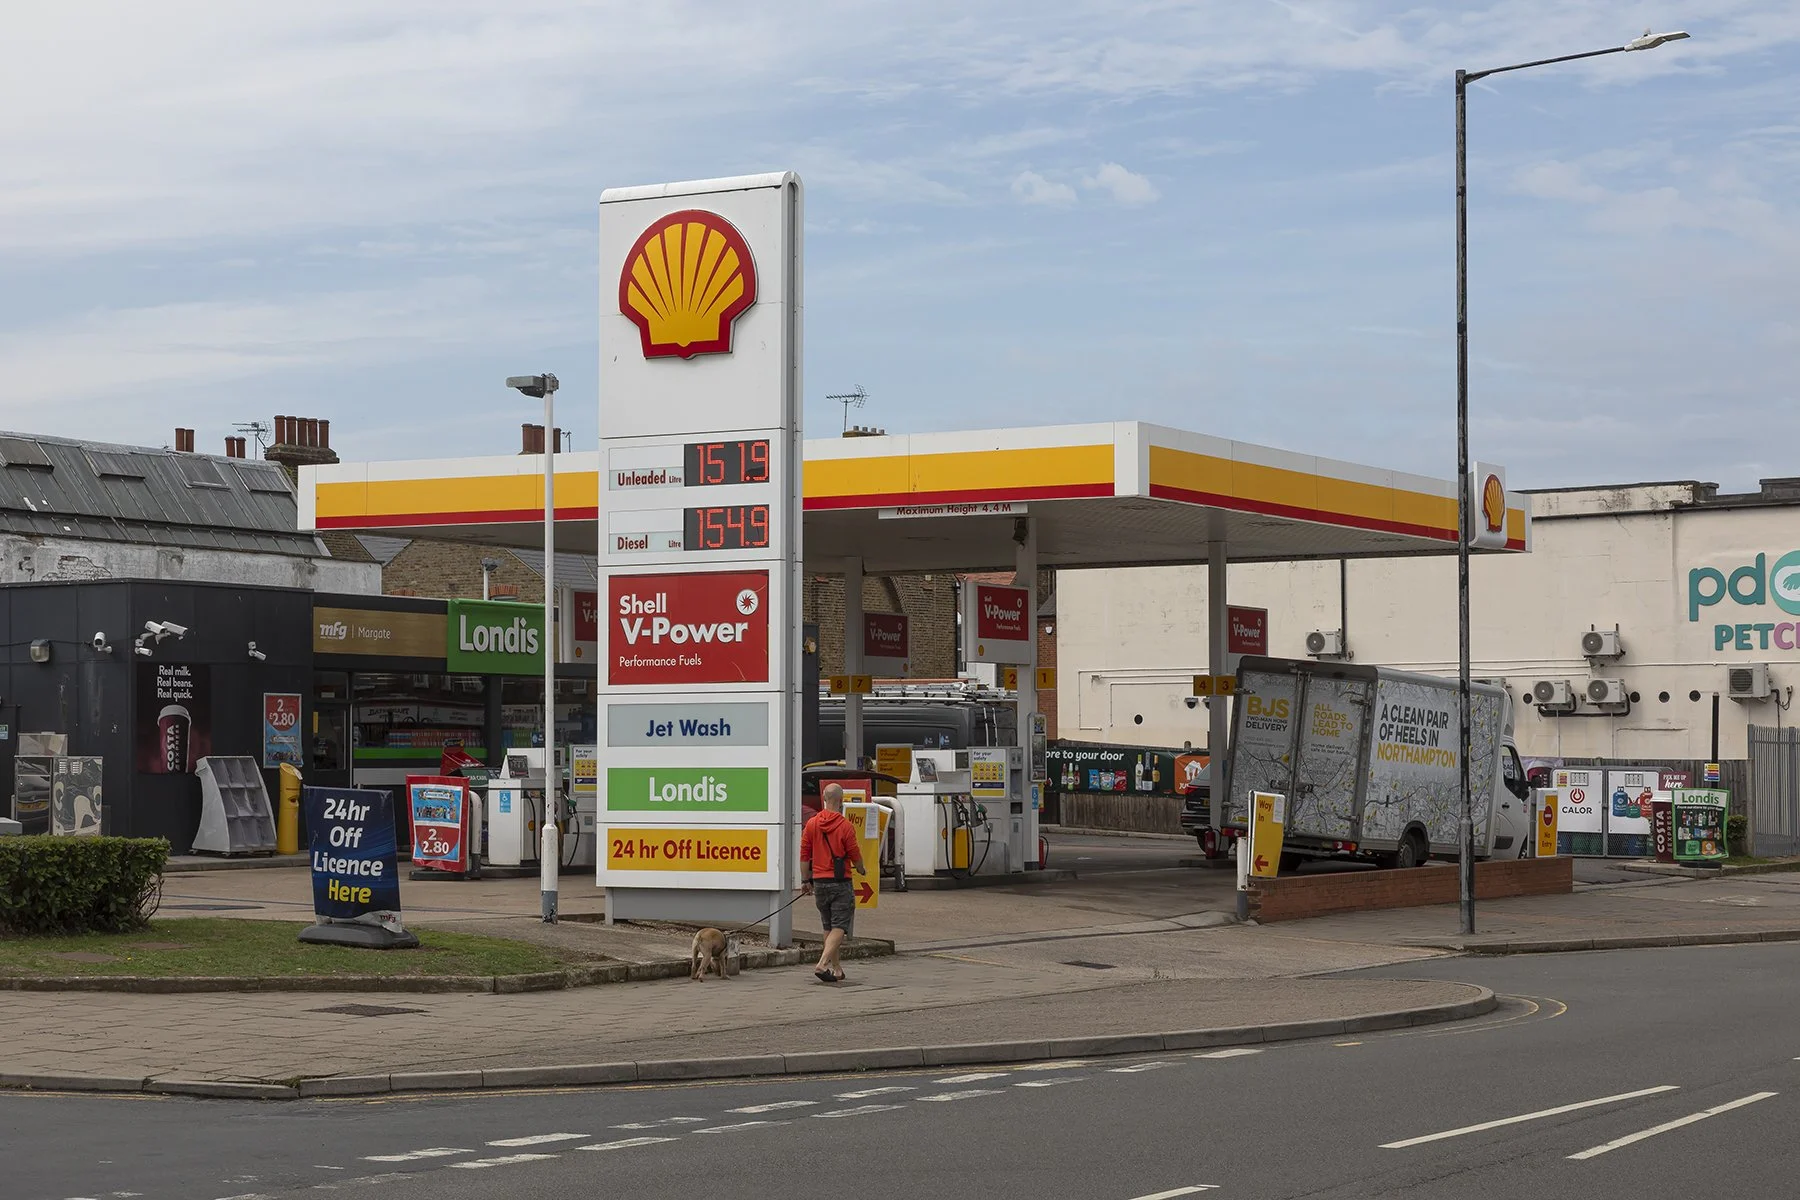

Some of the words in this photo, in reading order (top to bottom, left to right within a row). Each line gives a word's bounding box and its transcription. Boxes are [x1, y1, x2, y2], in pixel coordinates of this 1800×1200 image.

[696, 441, 769, 484] 151.9
[617, 470, 666, 487] Unleaded
[668, 475, 682, 484] Litre
[896, 507, 943, 516] Maximum
[947, 504, 977, 514] Height
[982, 504, 999, 513] 4.4
[1001, 503, 1012, 512] M
[696, 506, 769, 549] 154.9
[617, 535, 648, 550] Diesel
[668, 539, 681, 548] Litre
[619, 592, 667, 615] Shell
[984, 604, 1021, 621] V-Power
[320, 621, 348, 640] mfg
[358, 626, 391, 642] Margate
[460, 614, 539, 654] Londis
[619, 616, 749, 645] V-Power
[870, 628, 901, 642] V-Power
[1233, 623, 1260, 638] V-Power
[619, 655, 677, 668] Performance
[679, 653, 702, 666] Fuels
[158, 665, 174, 676] Real
[174, 666, 191, 676] milk.
[1042, 672, 1047, 684] 1
[157, 676, 172, 687] Real
[836, 679, 843, 690] 8
[856, 679, 863, 689] 7
[1009, 673, 1017, 685] 2
[1199, 679, 1207, 690] 4
[1222, 680, 1229, 690] 3
[157, 688, 172, 698] Real
[173, 688, 193, 702] quick.
[277, 698, 284, 712] 2
[1247, 696, 1290, 719] BJS
[1314, 703, 1332, 712] ALL
[1313, 711, 1347, 722] ROADS
[1380, 703, 1389, 721] A
[1391, 704, 1425, 726] CLEAN
[1426, 709, 1449, 729] PAIR
[645, 719, 674, 738] Jet
[679, 718, 731, 737] Wash
[1245, 720, 1288, 732] DELIVERY
[1311, 727, 1340, 738] HOME
[1313, 719, 1338, 729] LEAD
[1340, 721, 1353, 731] TO
[1379, 722, 1394, 741] OF
[1395, 724, 1428, 746] HEELS
[1428, 729, 1439, 747] IN
[167, 725, 175, 771] COSTA
[1377, 742, 1457, 768] NORTHAMPTON
[1045, 751, 1060, 759] ore
[1063, 751, 1074, 759] to
[1075, 751, 1099, 762] your
[1100, 750, 1125, 761] door
[649, 775, 728, 802] Londis
[1664, 779, 1684, 789] here
[1681, 792, 1720, 804] Londis
[323, 798, 370, 821] 24hr
[1259, 800, 1273, 812] Way
[1561, 806, 1593, 815] CALOR
[848, 813, 864, 828] Way
[1258, 813, 1265, 822] In
[329, 825, 363, 848] Off
[428, 828, 437, 841] 2
[1656, 810, 1666, 853] COSTA
[612, 839, 635, 859] 24
[639, 838, 659, 859] hr
[663, 839, 692, 860] Off
[696, 840, 761, 861] Licence
[313, 850, 384, 877] Licence
[328, 878, 372, 904] Here
[379, 913, 396, 924] mfg
